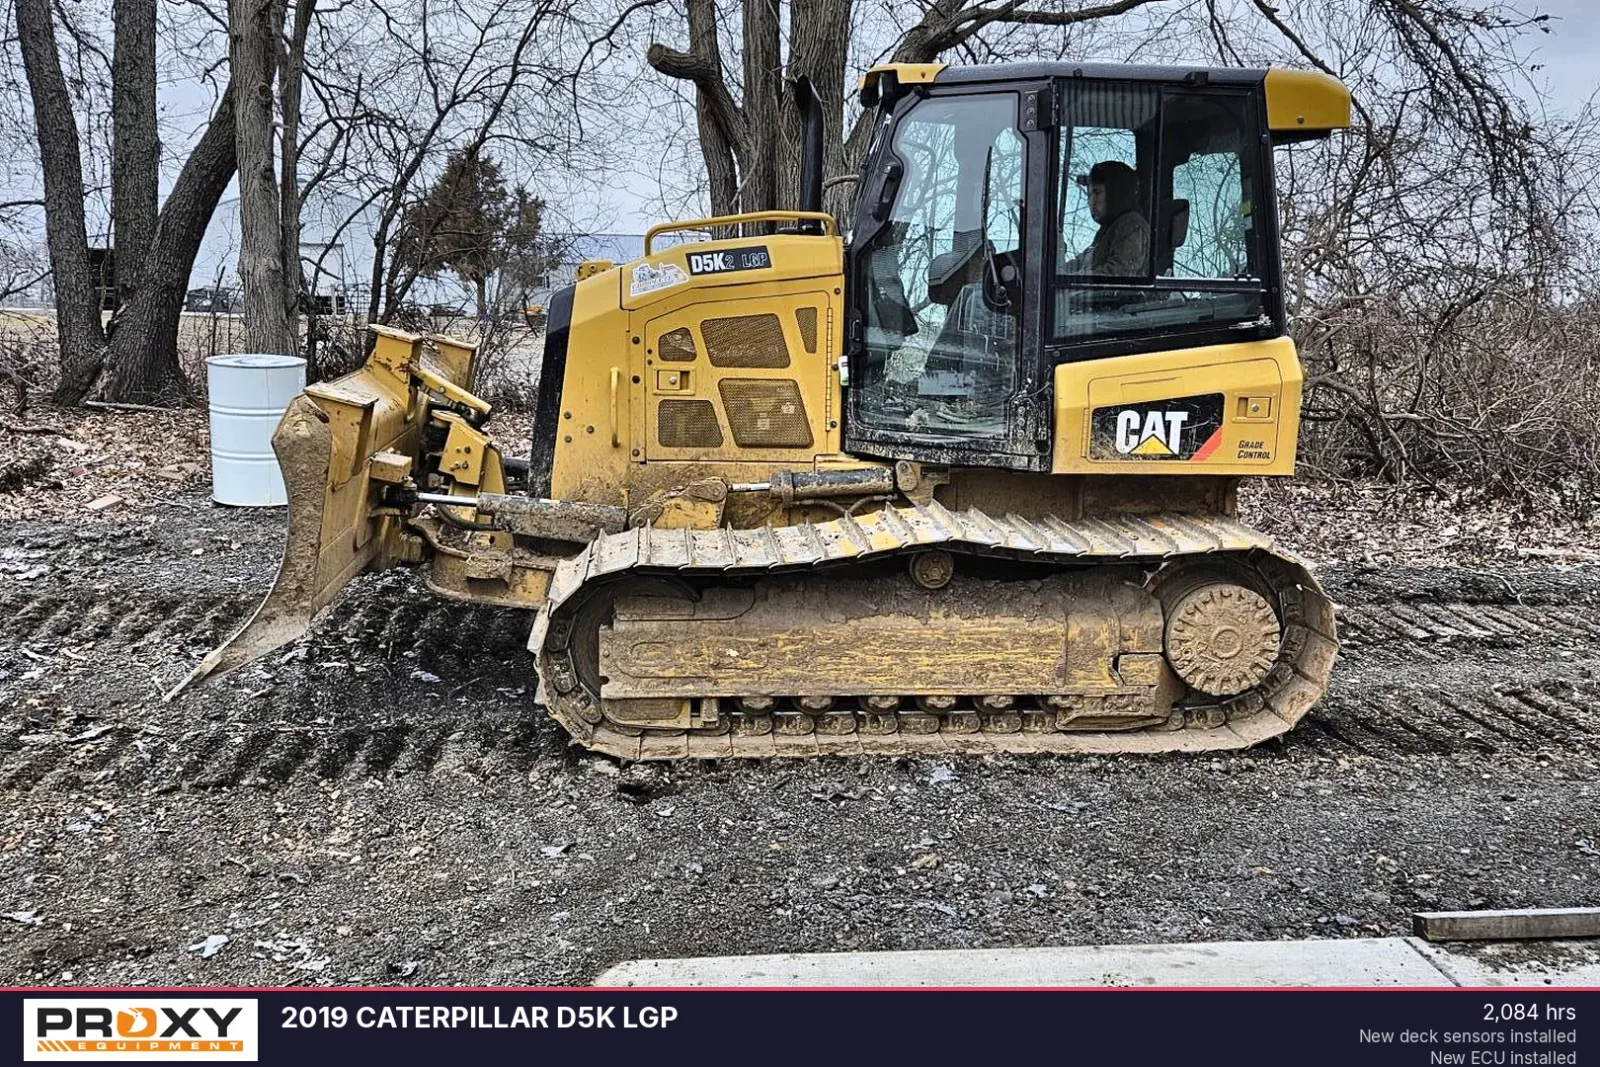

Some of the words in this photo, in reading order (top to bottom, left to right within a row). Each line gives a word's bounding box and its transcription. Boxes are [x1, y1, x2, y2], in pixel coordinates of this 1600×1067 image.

[742, 252, 768, 269] LGP
[1115, 410, 1188, 455] CAT
[1238, 440, 1264, 449] GRADE
[1237, 449, 1270, 459] CONTROL
